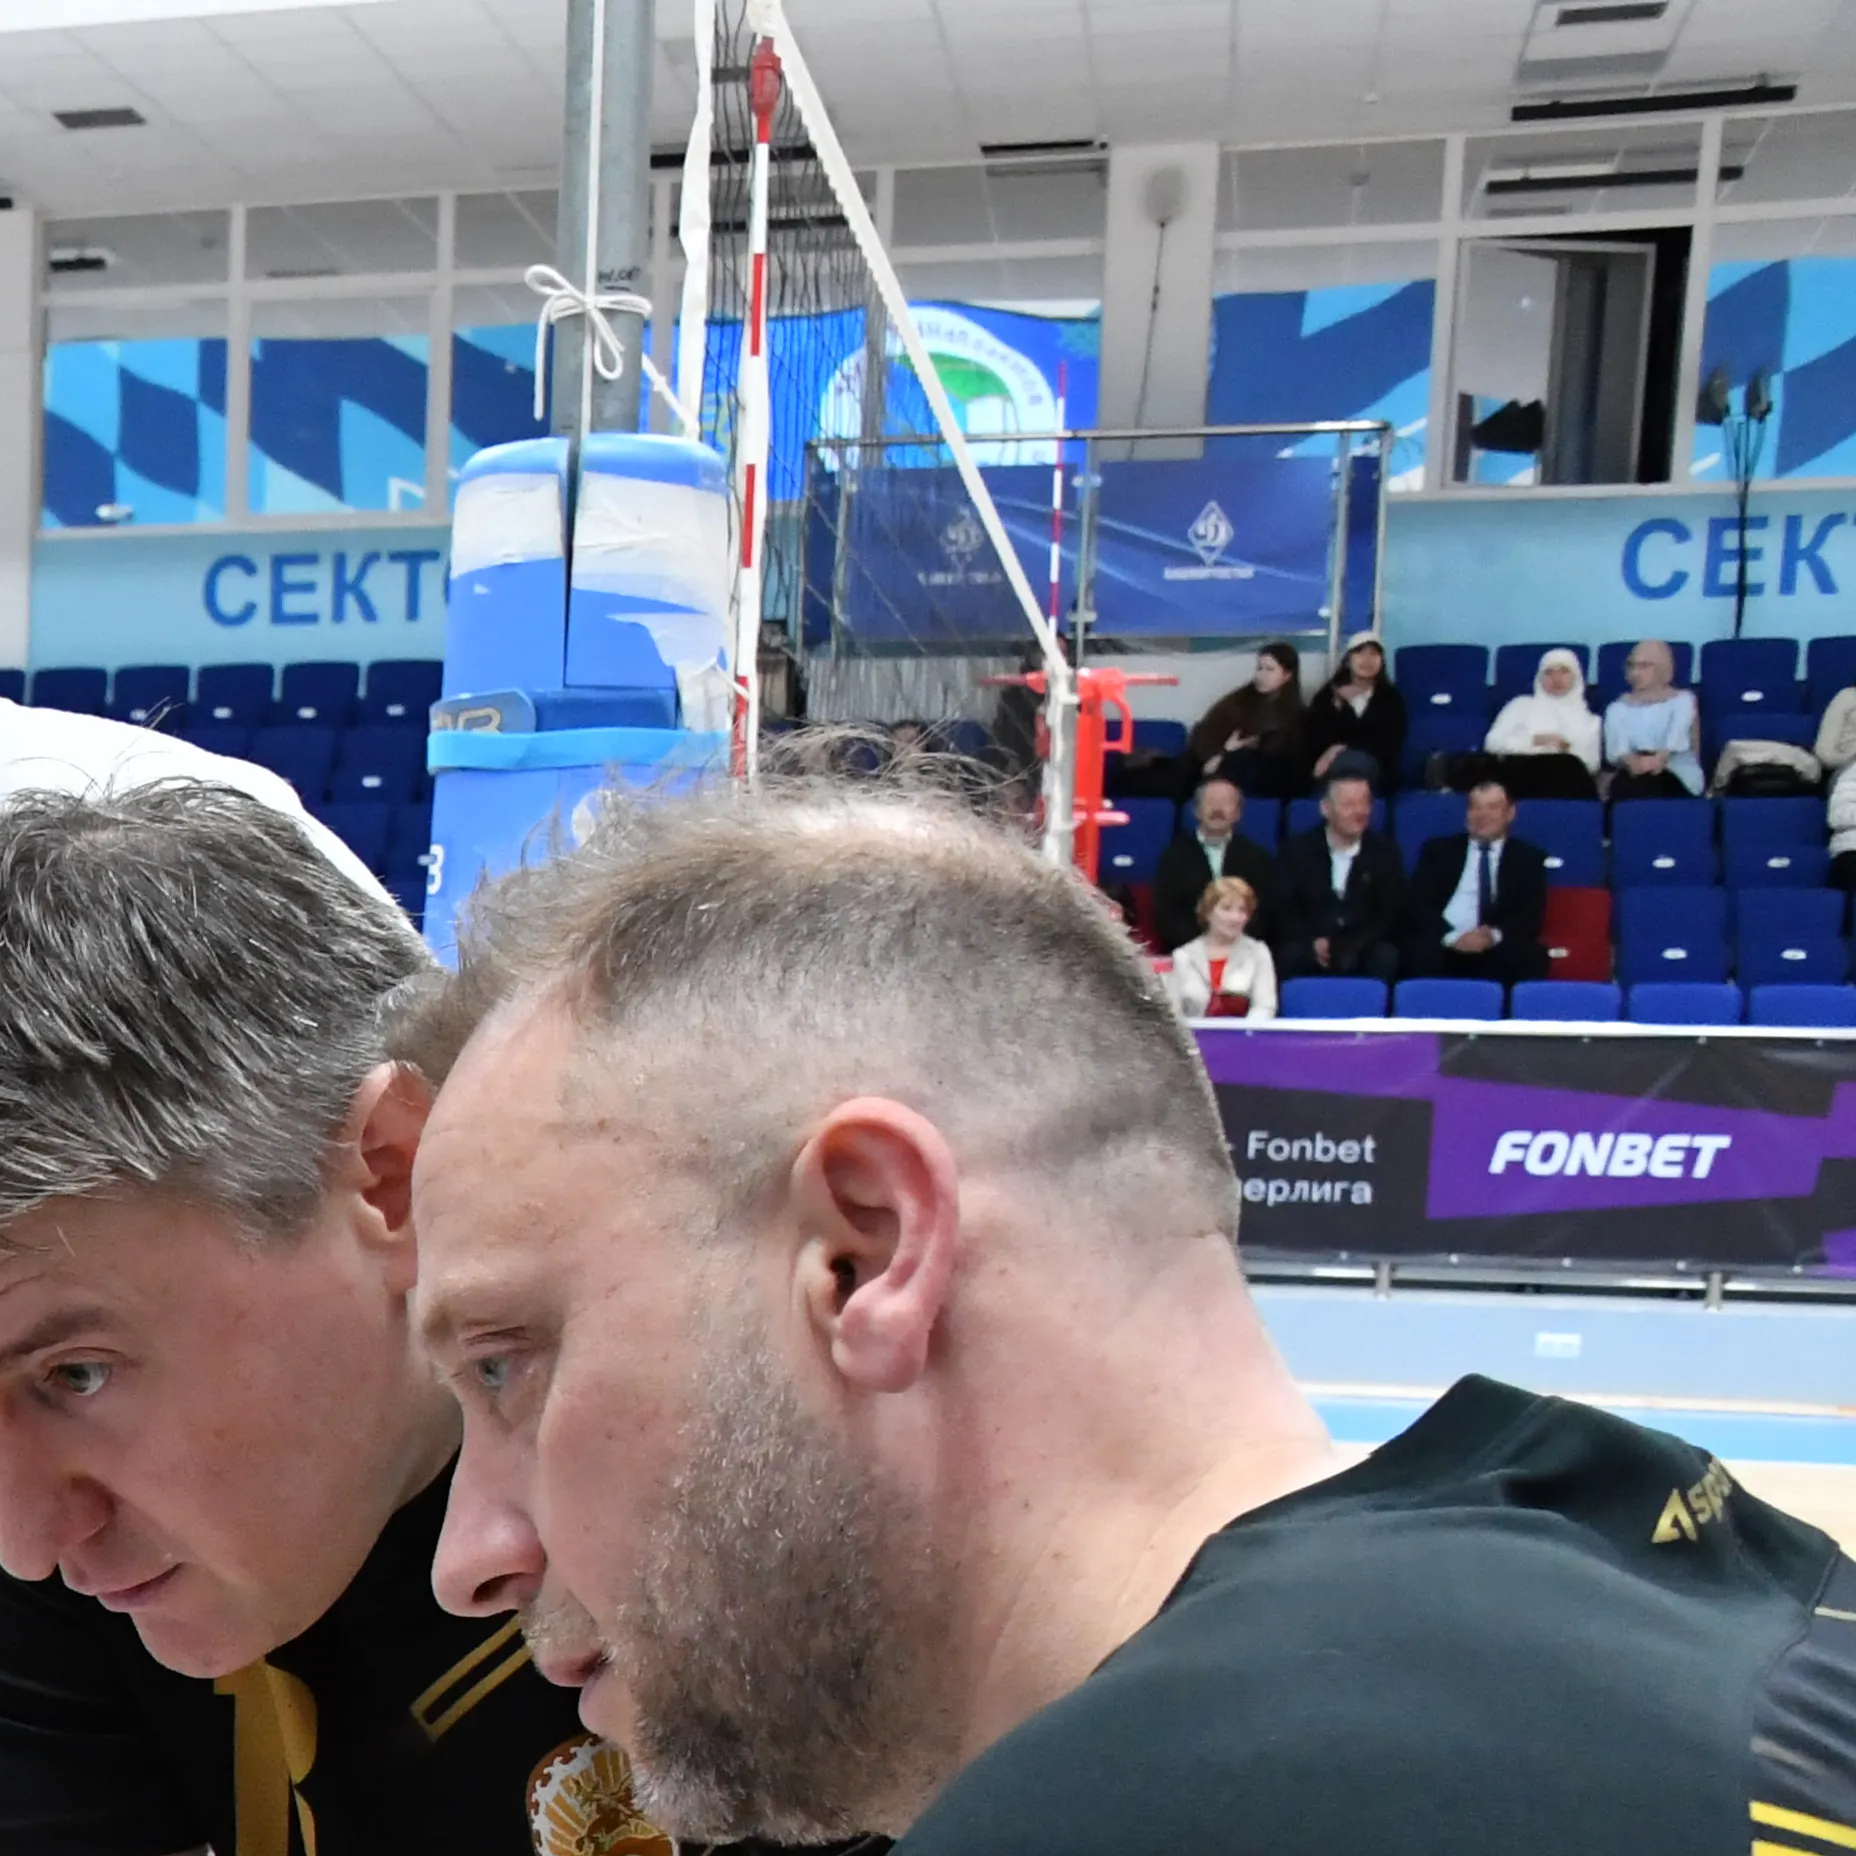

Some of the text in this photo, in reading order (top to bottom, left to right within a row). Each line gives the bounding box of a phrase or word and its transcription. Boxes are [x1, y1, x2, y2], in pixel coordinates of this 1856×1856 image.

[1621, 512, 1856, 600] СЕК
[203, 550, 451, 627] СЕКТ
[1247, 1130, 1376, 1163] Fonbet
[1489, 1130, 1732, 1178] FONBET
[1239, 1177, 1374, 1207] ерлига
